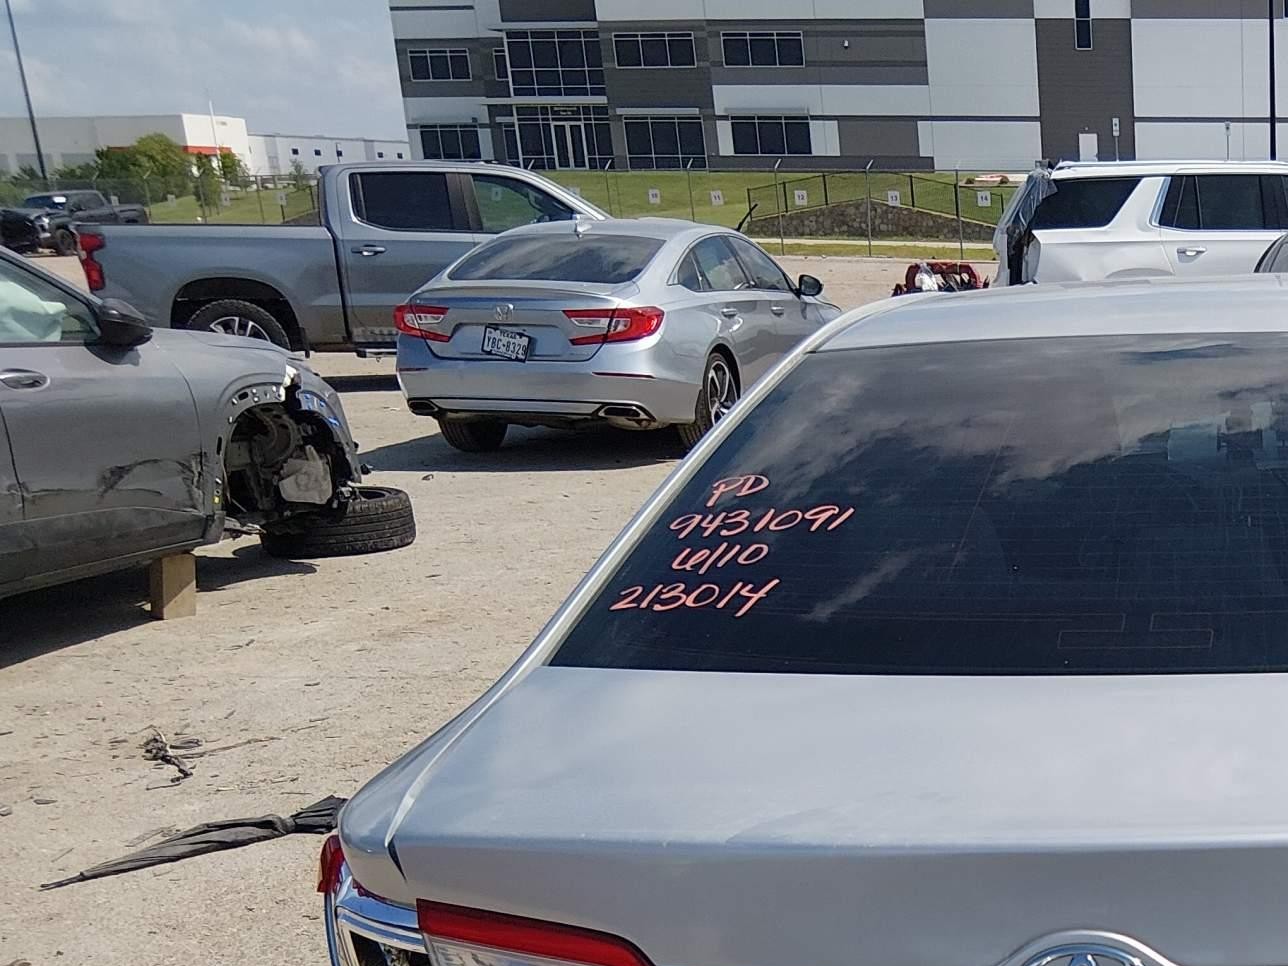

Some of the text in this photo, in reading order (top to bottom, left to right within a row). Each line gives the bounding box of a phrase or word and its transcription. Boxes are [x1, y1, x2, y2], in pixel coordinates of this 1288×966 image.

[707, 474, 770, 507] PD
[669, 505, 855, 539] 9431091
[609, 578, 780, 617] 213014
